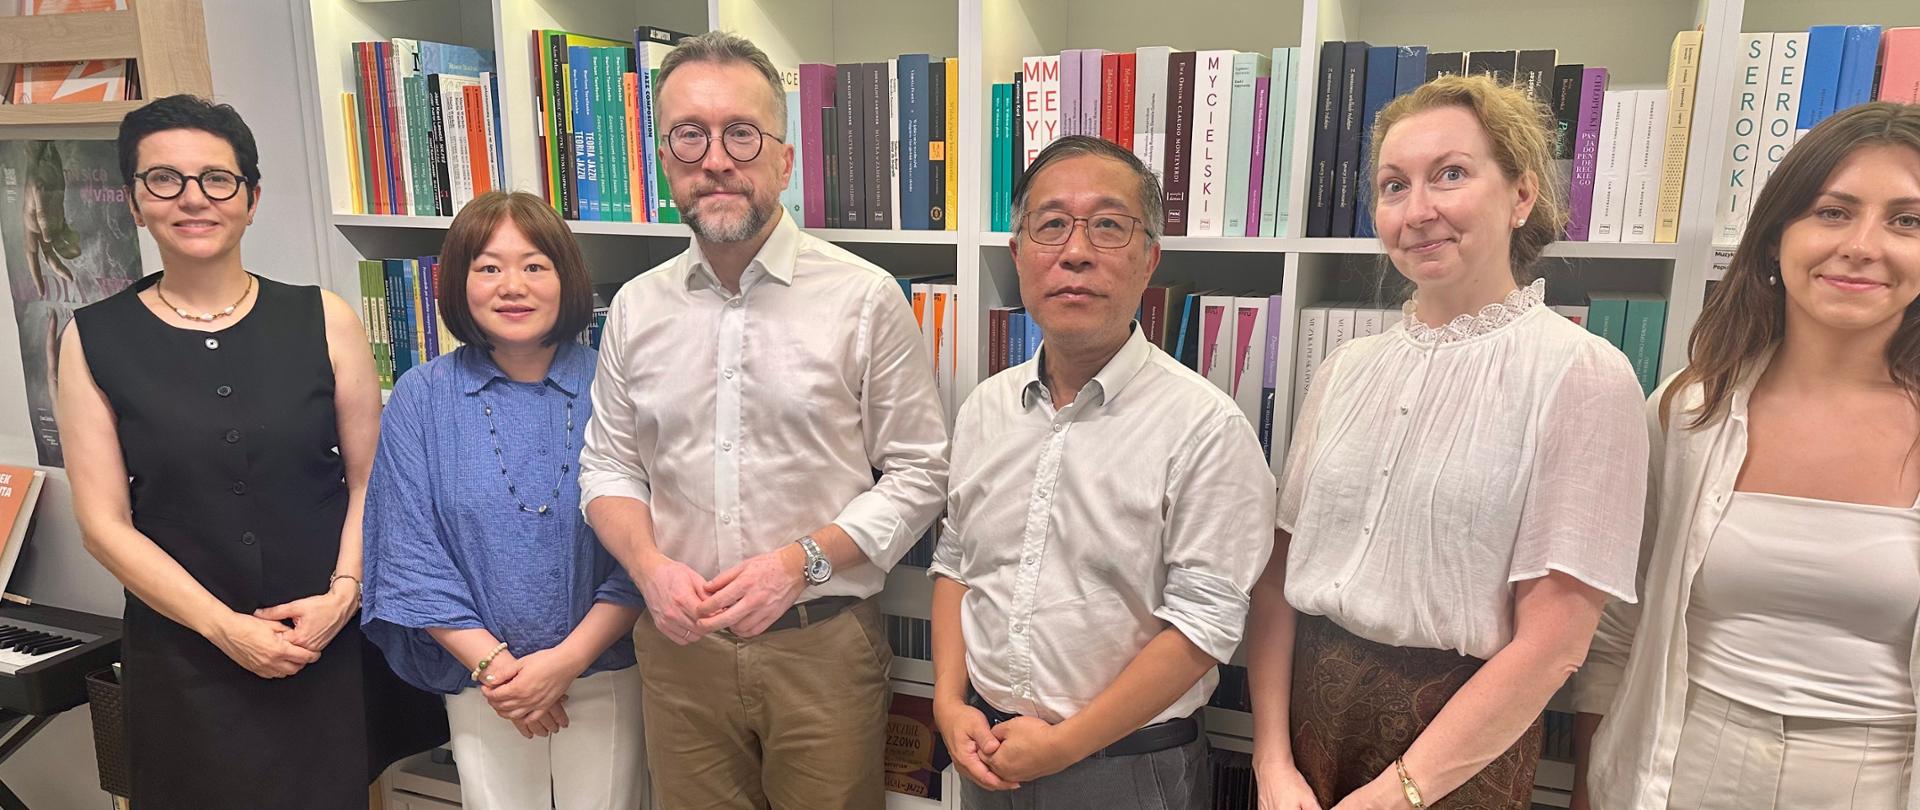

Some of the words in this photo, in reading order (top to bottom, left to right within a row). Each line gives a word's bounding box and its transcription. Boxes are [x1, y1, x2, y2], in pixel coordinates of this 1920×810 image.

[781, 70, 798, 86] ACE
[645, 91, 653, 138] COMPOSITION
[1025, 62, 1040, 166] MEYE
[1043, 61, 1058, 140] MEY
[1590, 75, 1602, 128] CHŁOPECKI
[1768, 40, 1797, 168] SEROC
[1203, 58, 1219, 212] MYCIELSKI
[1730, 40, 1761, 212] SEROCKI
[575, 131, 584, 156] TEORIA
[586, 133, 595, 158] TEORIA
[577, 158, 586, 180] JAZZU
[586, 159, 597, 181] JAZZU
[1307, 318, 1316, 346] MUZYKA
[1265, 393, 1274, 408] Nowa
[886, 736, 921, 749] ZZOWO
